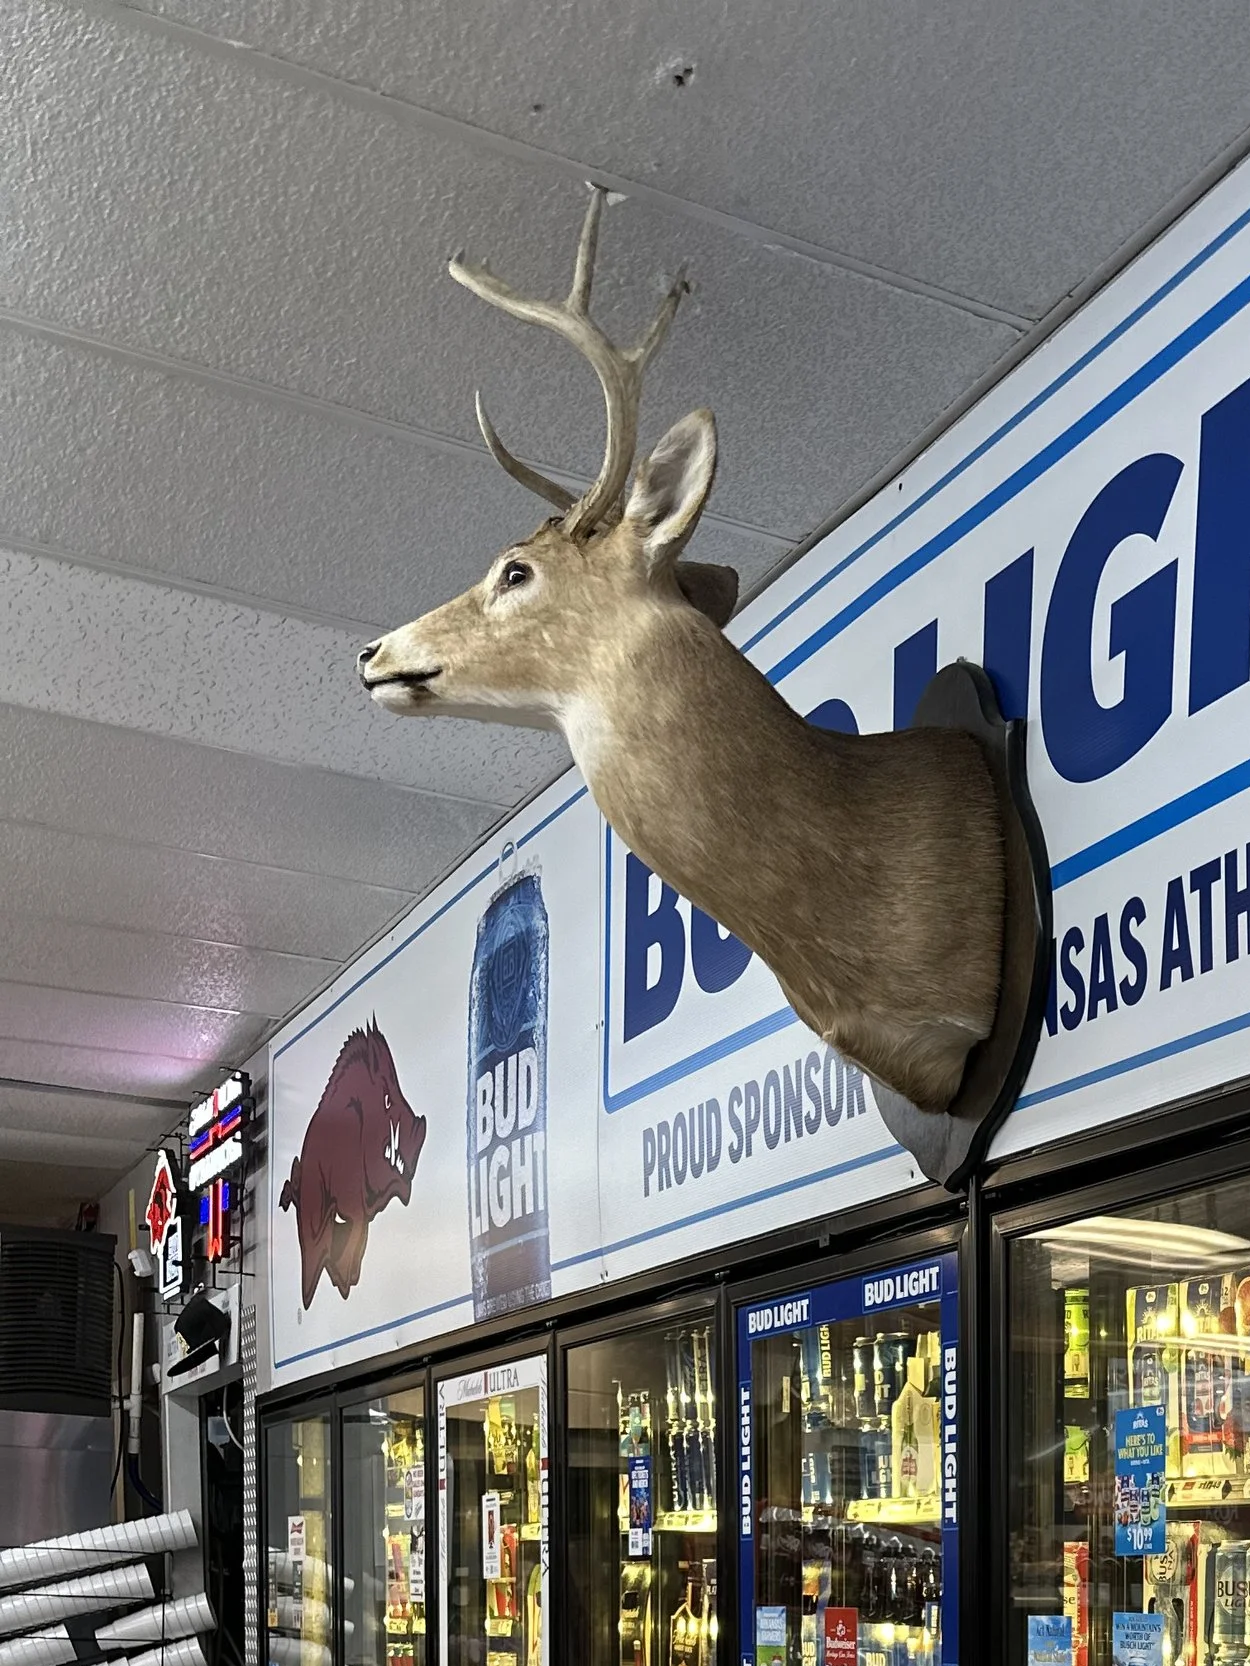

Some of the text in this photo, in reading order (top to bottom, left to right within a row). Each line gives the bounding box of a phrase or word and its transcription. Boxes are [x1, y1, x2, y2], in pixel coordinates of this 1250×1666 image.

[477, 1047, 538, 1152] BUD
[642, 1049, 866, 1198] PROUD SPONSOR
[471, 1132, 545, 1239] LIGHT
[864, 1266, 939, 1307] BUD LIGHT
[748, 1299, 809, 1334] BUD LIGHT
[489, 1368, 519, 1393] ULTRA
[821, 1353, 831, 1378] BUD
[945, 1347, 957, 1523] BUD LIGHT
[1118, 1447, 1135, 1459] WHAT
[1125, 1433, 1156, 1446] HERE'S TO
[741, 1387, 751, 1535] BUD LIGHT
[826, 1637, 856, 1650] Budweiser
